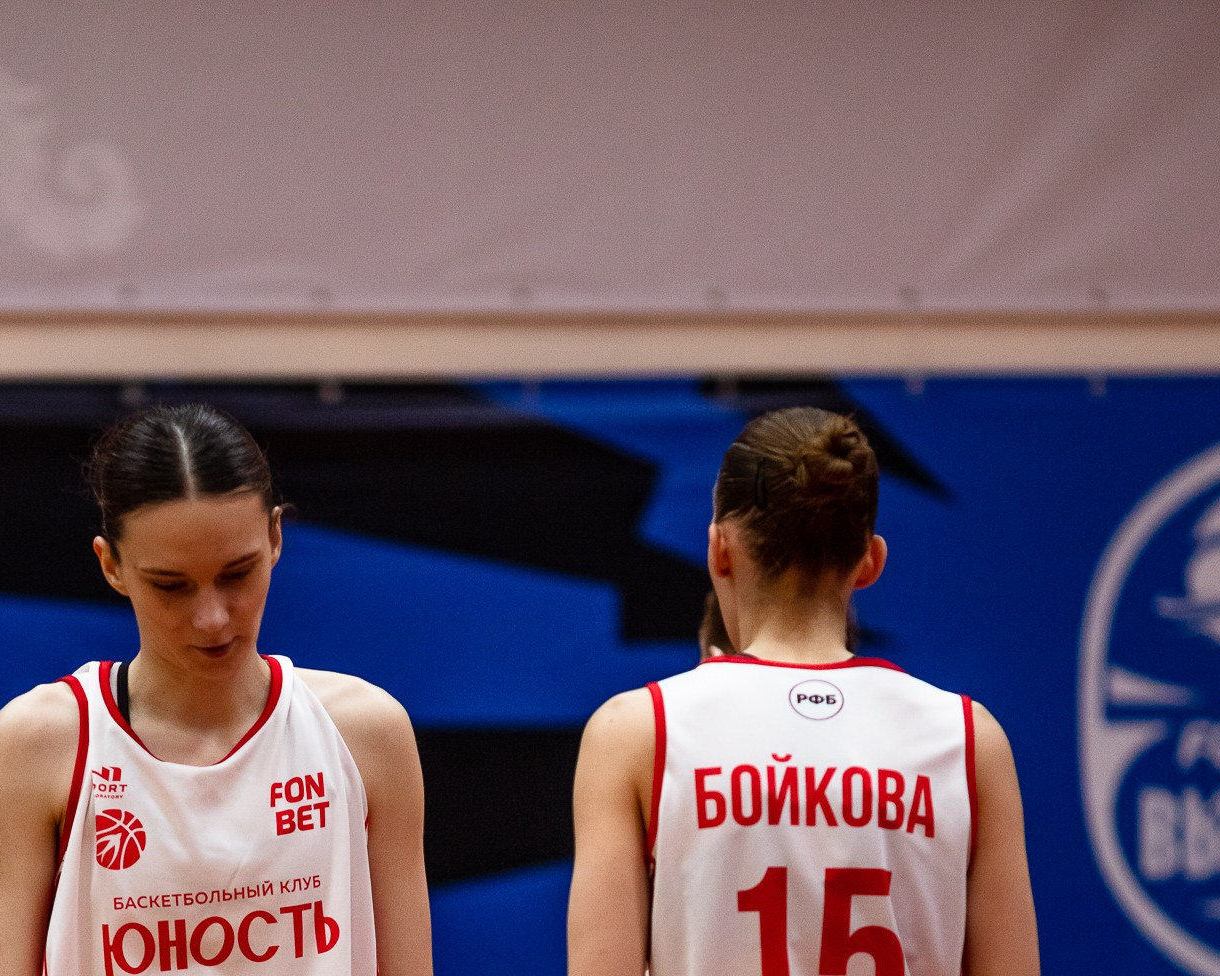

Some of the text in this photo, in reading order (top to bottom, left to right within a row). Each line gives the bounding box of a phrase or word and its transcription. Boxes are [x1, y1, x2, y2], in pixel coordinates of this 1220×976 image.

[796, 692, 837, 706] РФБ
[269, 771, 326, 808] FON
[694, 753, 936, 838] БОЙКОВА
[275, 800, 331, 837] BET
[113, 874, 322, 911] БАСКЕТБОЛЬНЫЙ КЛУБ
